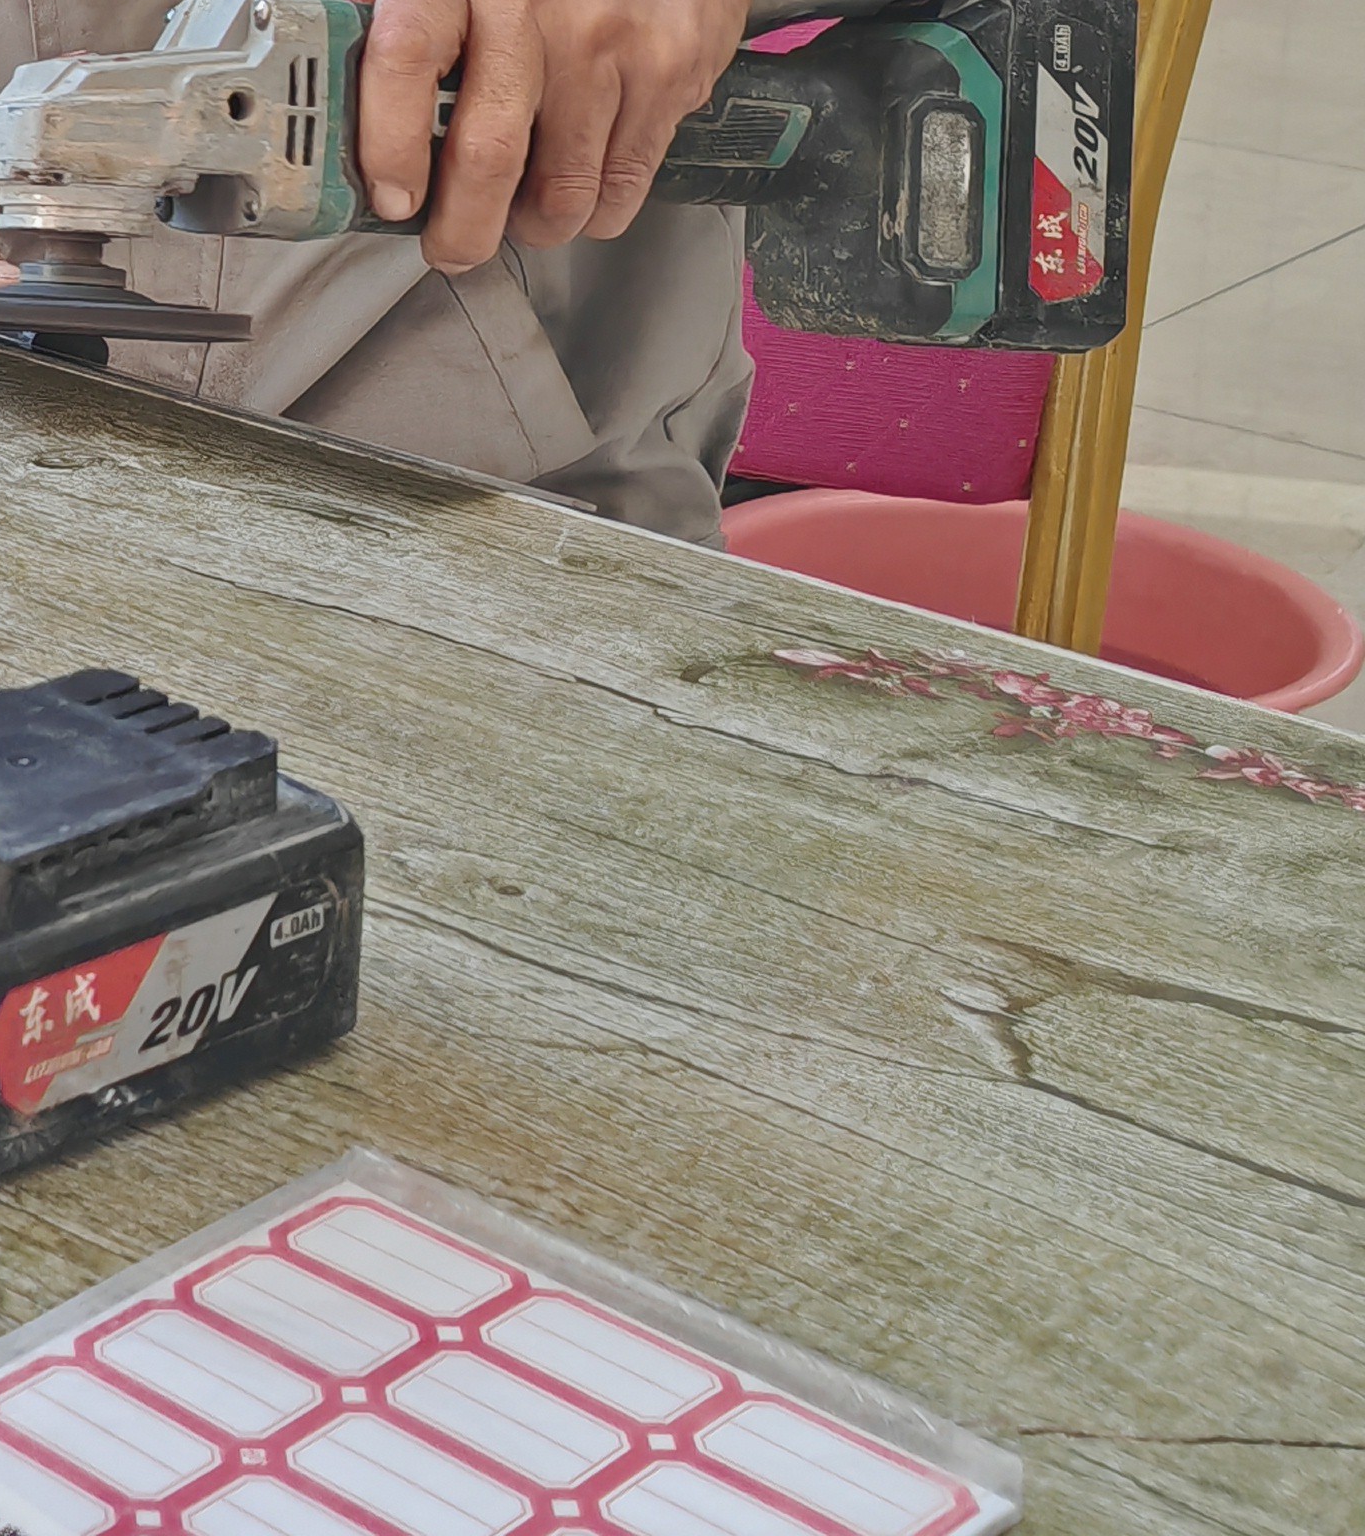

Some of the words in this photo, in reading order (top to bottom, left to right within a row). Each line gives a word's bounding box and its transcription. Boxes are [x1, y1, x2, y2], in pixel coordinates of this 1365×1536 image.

[1071, 83, 1102, 182] 20V
[1033, 211, 1068, 275] 东成
[273, 909, 321, 940] 4.0Ah
[19, 972, 101, 1047] 东成
[137, 964, 261, 1054] 20V
